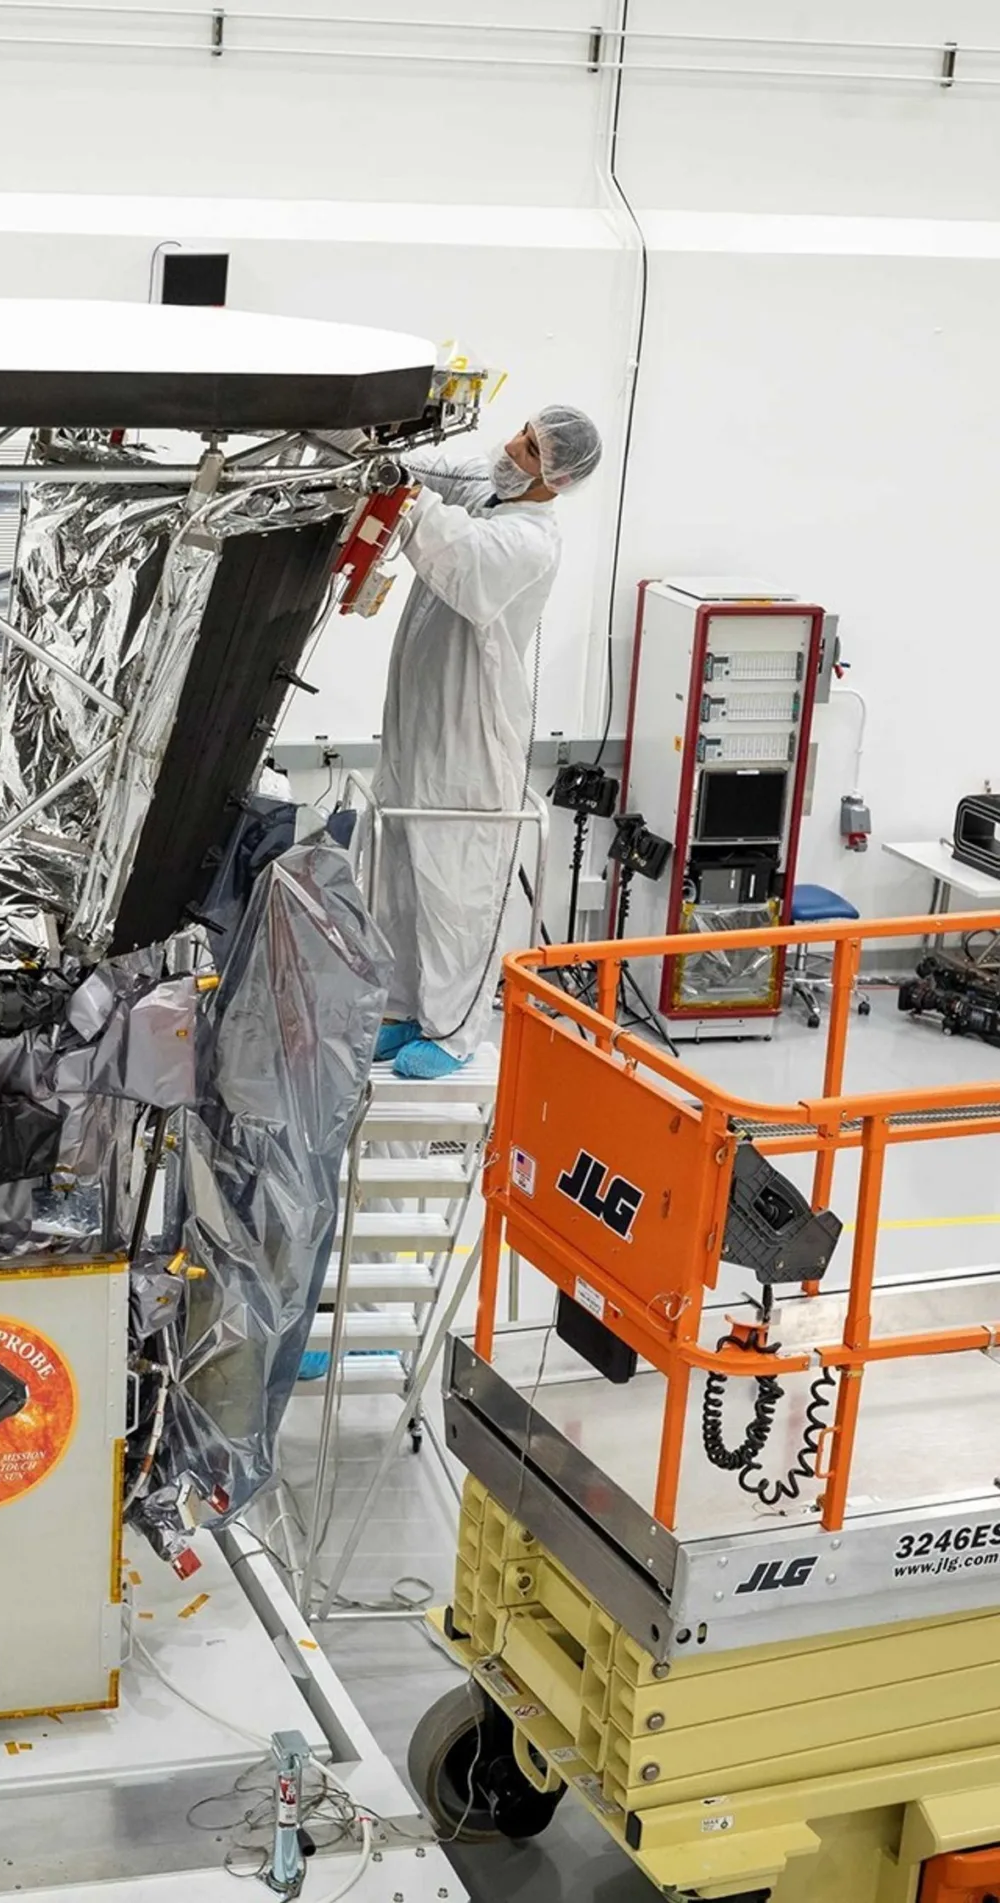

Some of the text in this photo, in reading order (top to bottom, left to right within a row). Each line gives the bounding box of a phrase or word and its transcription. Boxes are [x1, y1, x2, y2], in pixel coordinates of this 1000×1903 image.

[556, 1149, 645, 1239] JLG
[1, 1461, 37, 1472] TOUCH
[2, 1450, 46, 1461] MISSION
[4, 1471, 26, 1481] SUN
[896, 1523, 1000, 1560] 3246ES
[734, 1556, 819, 1595] JLG
[894, 1552, 999, 1578] www.jlg.com
